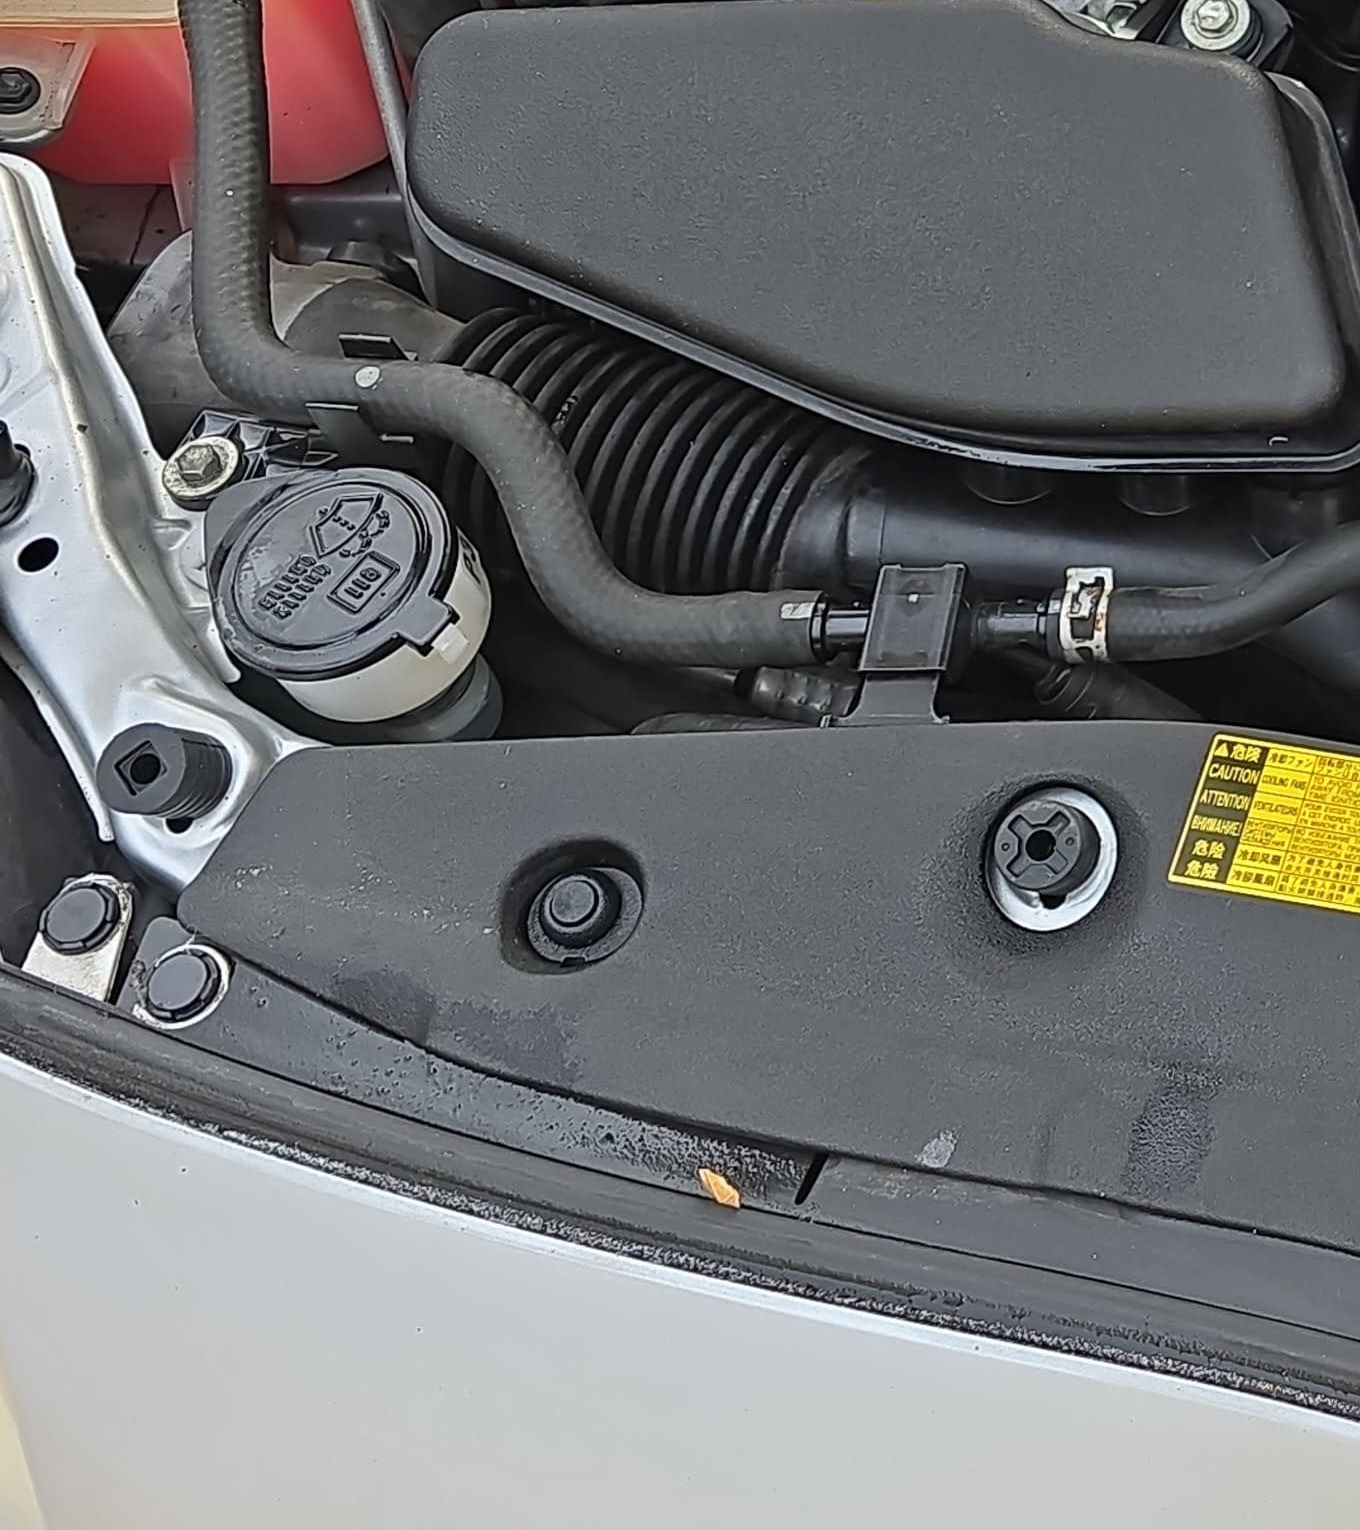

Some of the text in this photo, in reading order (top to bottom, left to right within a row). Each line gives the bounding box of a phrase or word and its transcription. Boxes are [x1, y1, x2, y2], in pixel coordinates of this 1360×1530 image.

[1207, 762, 1260, 785] CAUTION
[1198, 788, 1252, 811] ATTENTION
[1191, 837, 1227, 860] 危险
